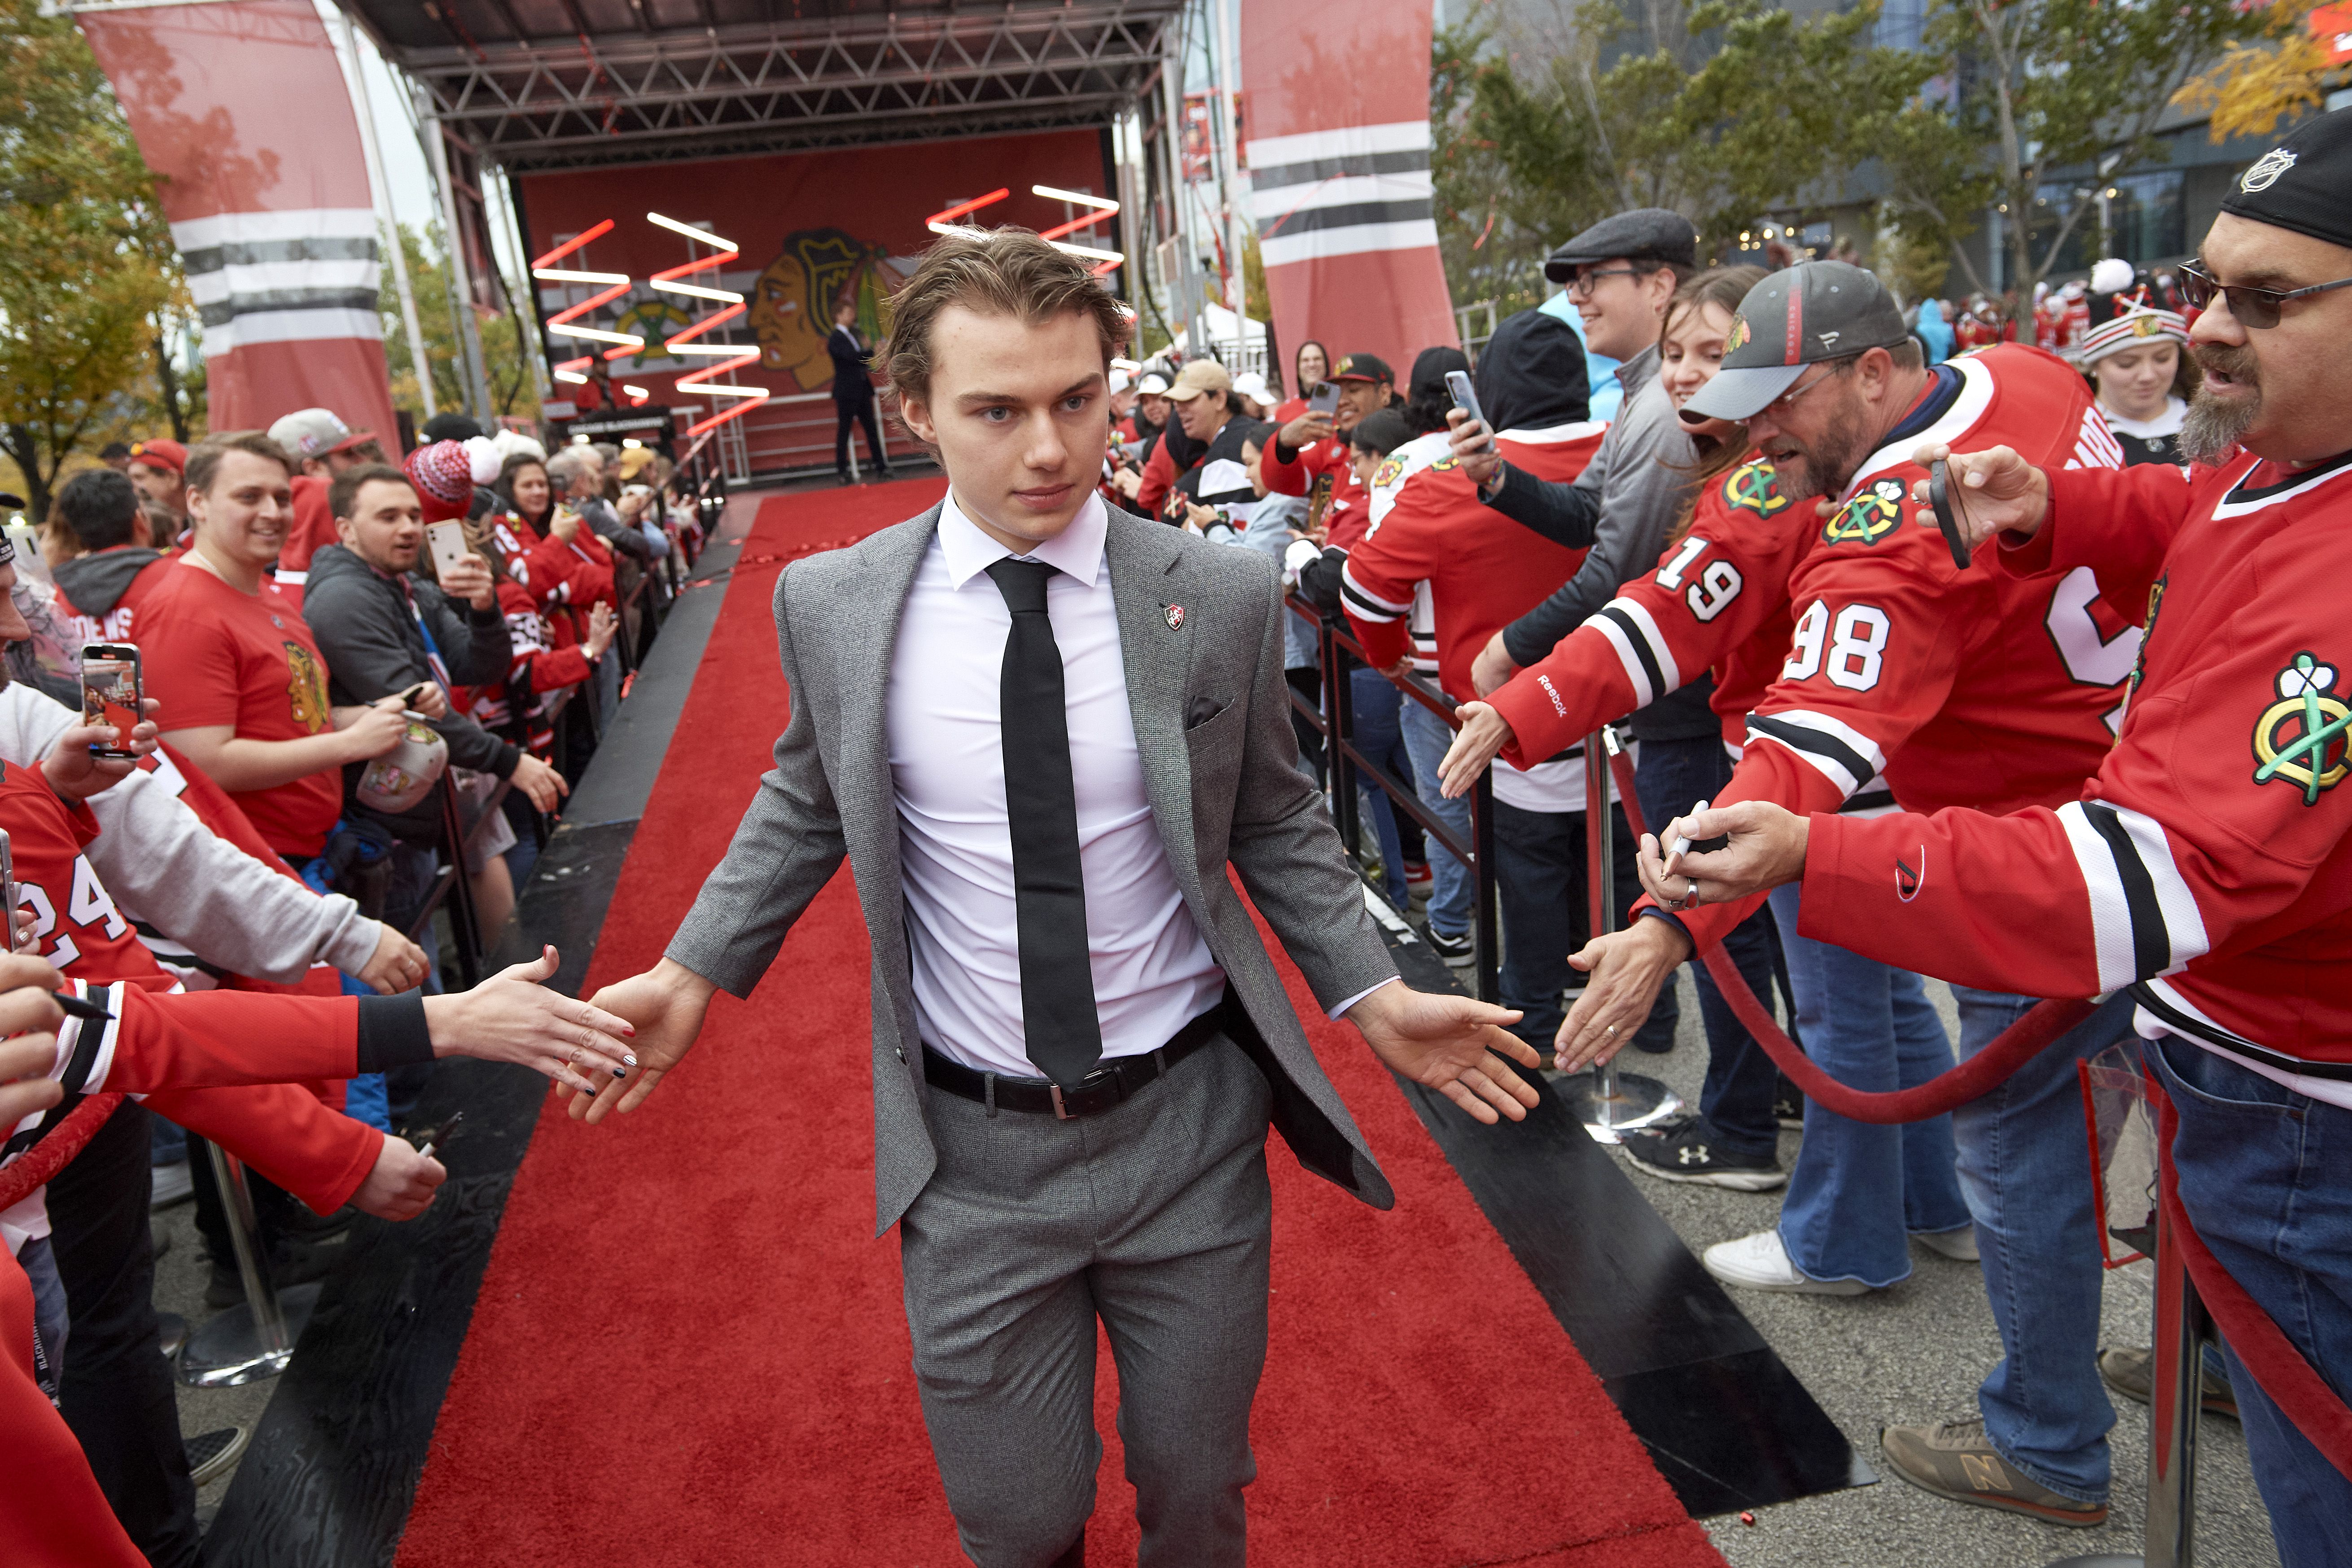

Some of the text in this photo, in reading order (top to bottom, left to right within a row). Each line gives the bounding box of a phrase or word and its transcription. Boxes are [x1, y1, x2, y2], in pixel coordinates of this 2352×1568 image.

[1655, 536, 1743, 624] 19
[1783, 599, 1891, 693] 98
[1537, 675, 1567, 718] Reebok
[16, 852, 127, 971] 24
